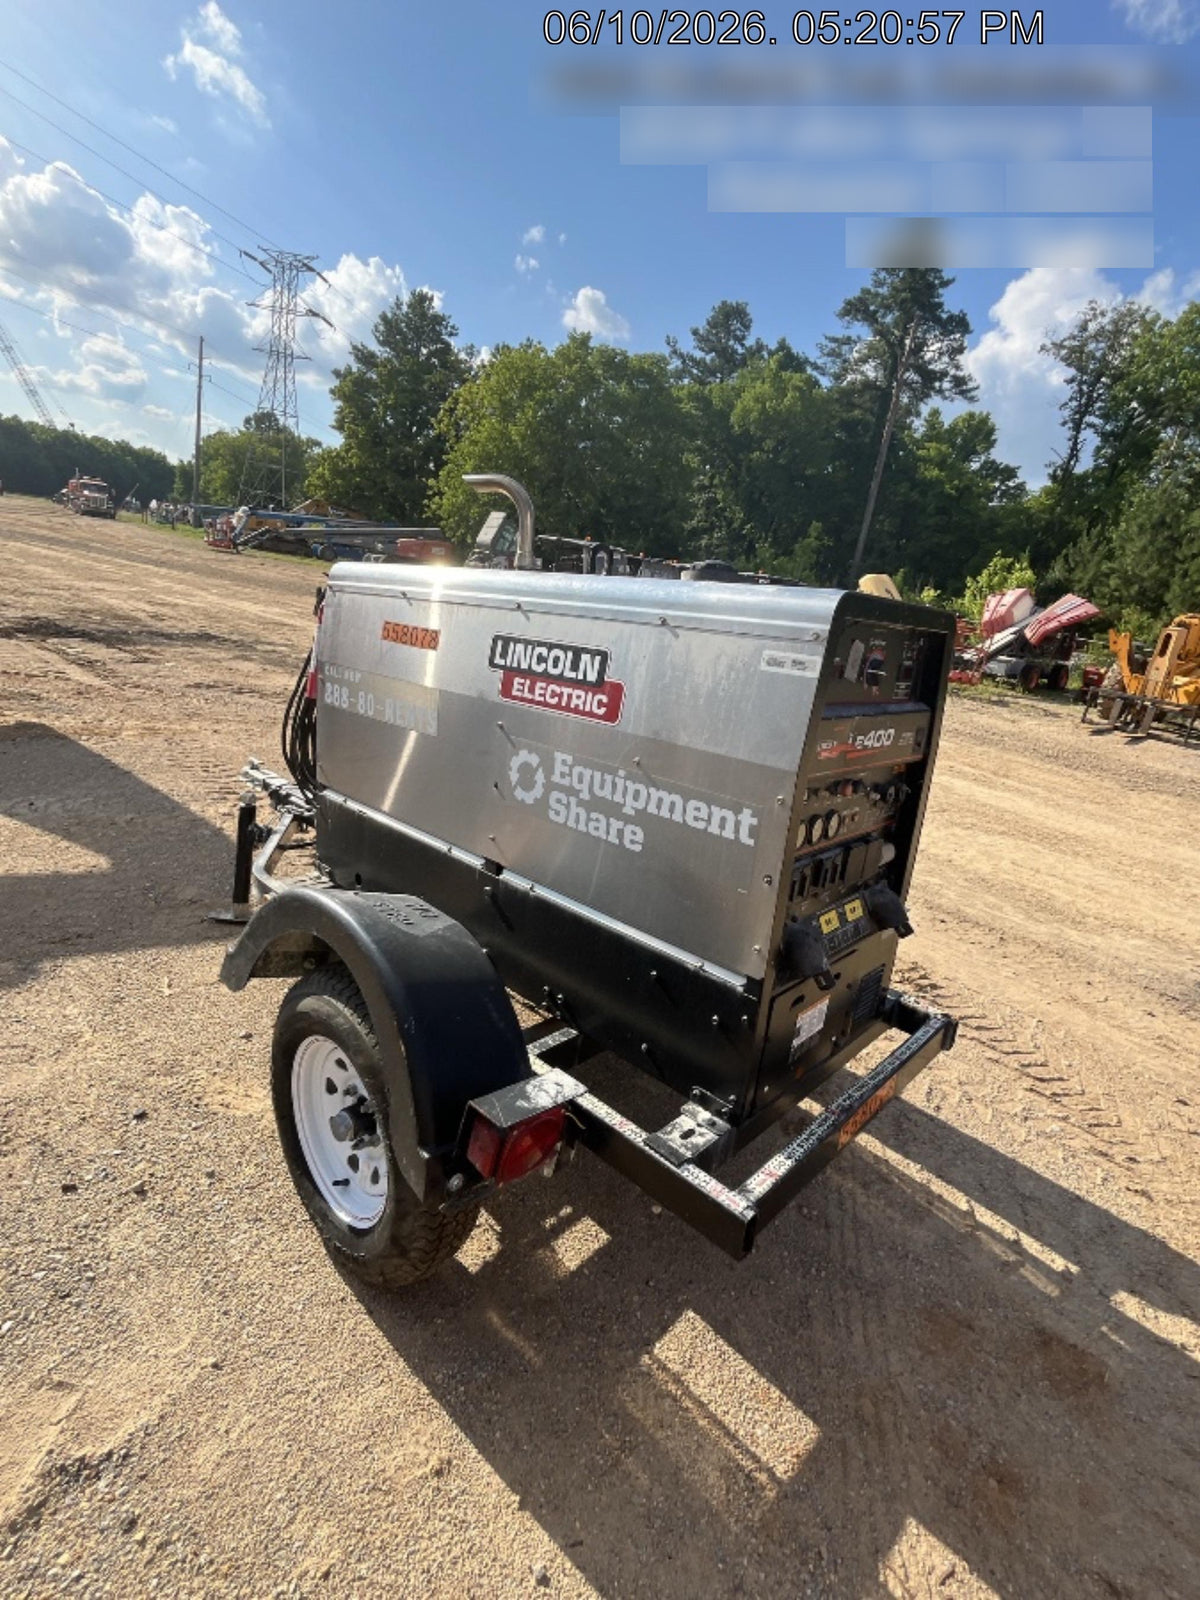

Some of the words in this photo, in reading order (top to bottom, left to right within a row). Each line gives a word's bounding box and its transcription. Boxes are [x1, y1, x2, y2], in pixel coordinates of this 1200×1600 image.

[382, 621, 440, 650] 558078
[494, 639, 602, 683] LINCOLN
[511, 676, 609, 715] ELECTRIC
[548, 790, 645, 852] Share
[550, 751, 758, 847] Equipment
